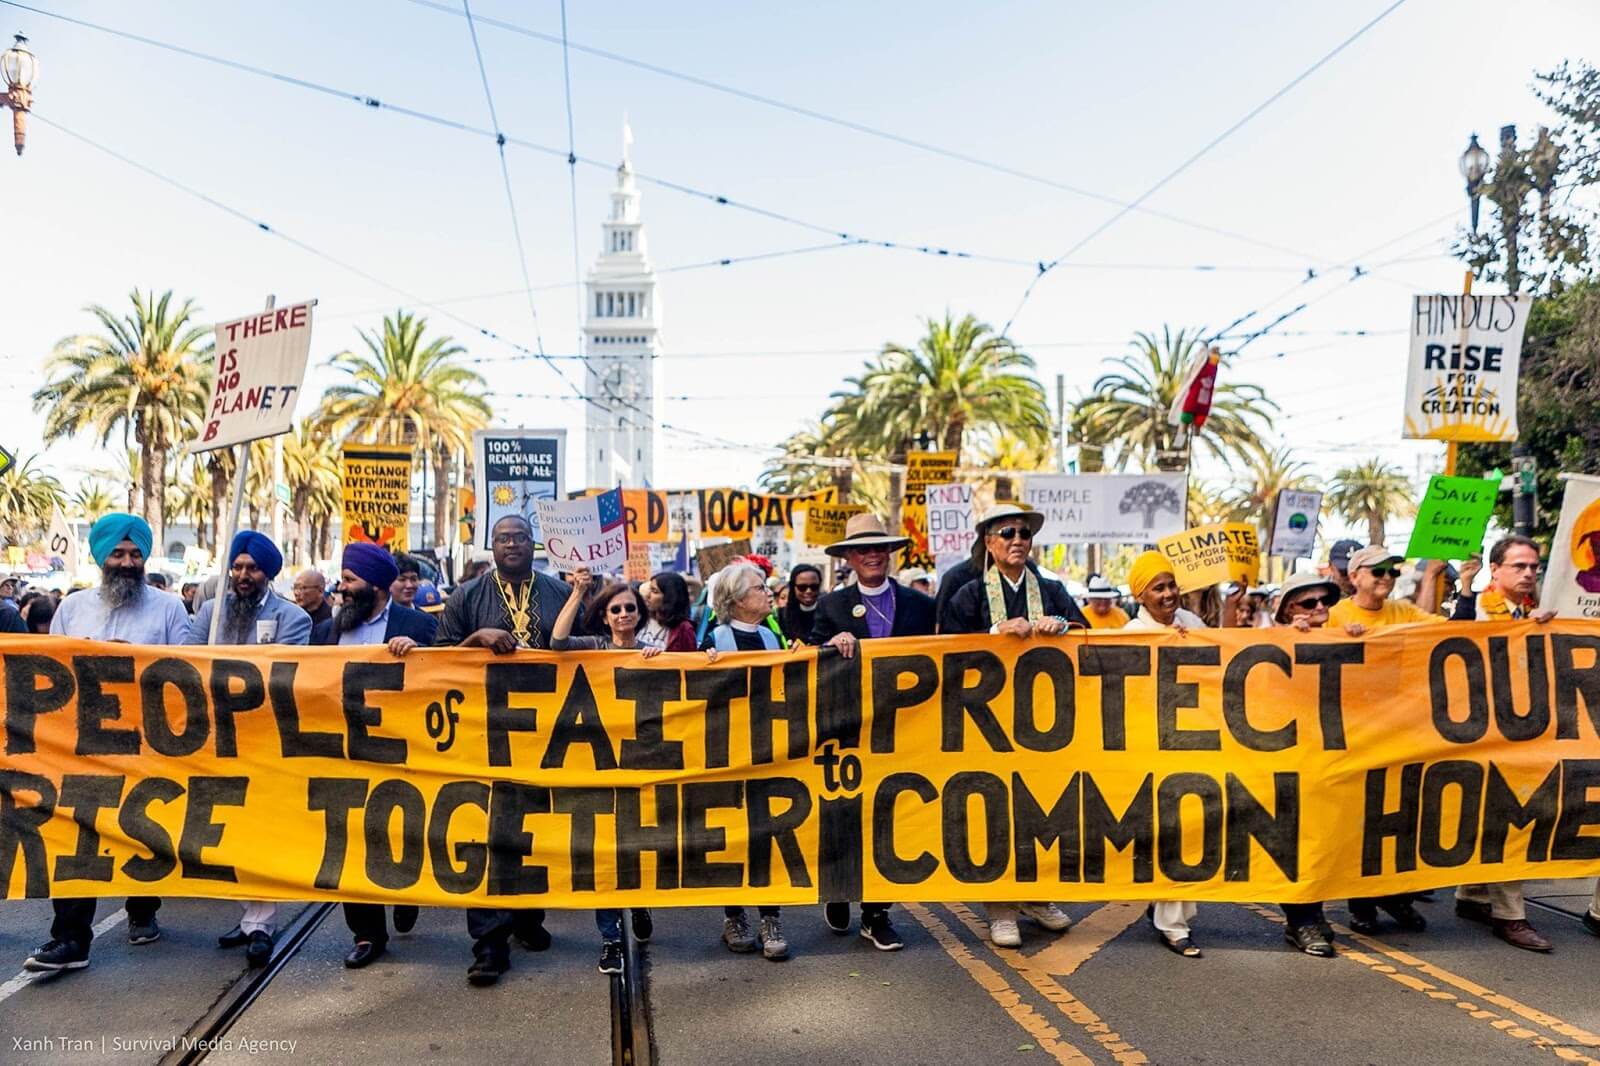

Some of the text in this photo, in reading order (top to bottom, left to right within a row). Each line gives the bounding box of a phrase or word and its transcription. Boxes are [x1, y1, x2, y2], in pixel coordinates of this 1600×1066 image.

[225, 305, 307, 341] THERE
[1416, 295, 1518, 336] HINDUS
[219, 348, 237, 374] IS
[216, 371, 240, 396] NO
[1447, 373, 1476, 385] FOR
[1448, 386, 1475, 398] ALL
[210, 385, 297, 419] PLANET
[1421, 400, 1500, 416] CREATION
[203, 420, 220, 442] B
[488, 440, 521, 453] 100%
[488, 453, 553, 465] RENEWABLES
[347, 464, 408, 477] TO CHANGE
[509, 466, 551, 477] FOR ALL
[345, 477, 408, 490] EVERYTHING
[1432, 478, 1479, 503] SAVE
[353, 490, 399, 500] IT TAKES
[1029, 489, 1092, 503] TEMPLE
[345, 500, 408, 515] EVERYONE
[809, 507, 861, 521] CLIMAT
[1042, 507, 1083, 521] INAI
[540, 513, 594, 525] EPISCOPAL
[542, 525, 585, 536] CHURCH
[548, 533, 623, 562] CARES
[1171, 556, 1190, 567] THE
[1194, 546, 1233, 560] MORAL
[1186, 562, 1201, 572] OF
[1204, 555, 1226, 567] OUR
[871, 633, 1600, 752] PROTECT OUR
[3, 653, 809, 770] PEOPLE of FAITH
[814, 744, 861, 791] to
[871, 759, 1600, 883] COMMON HOME
[0, 769, 813, 899] RISE TOGETHER
